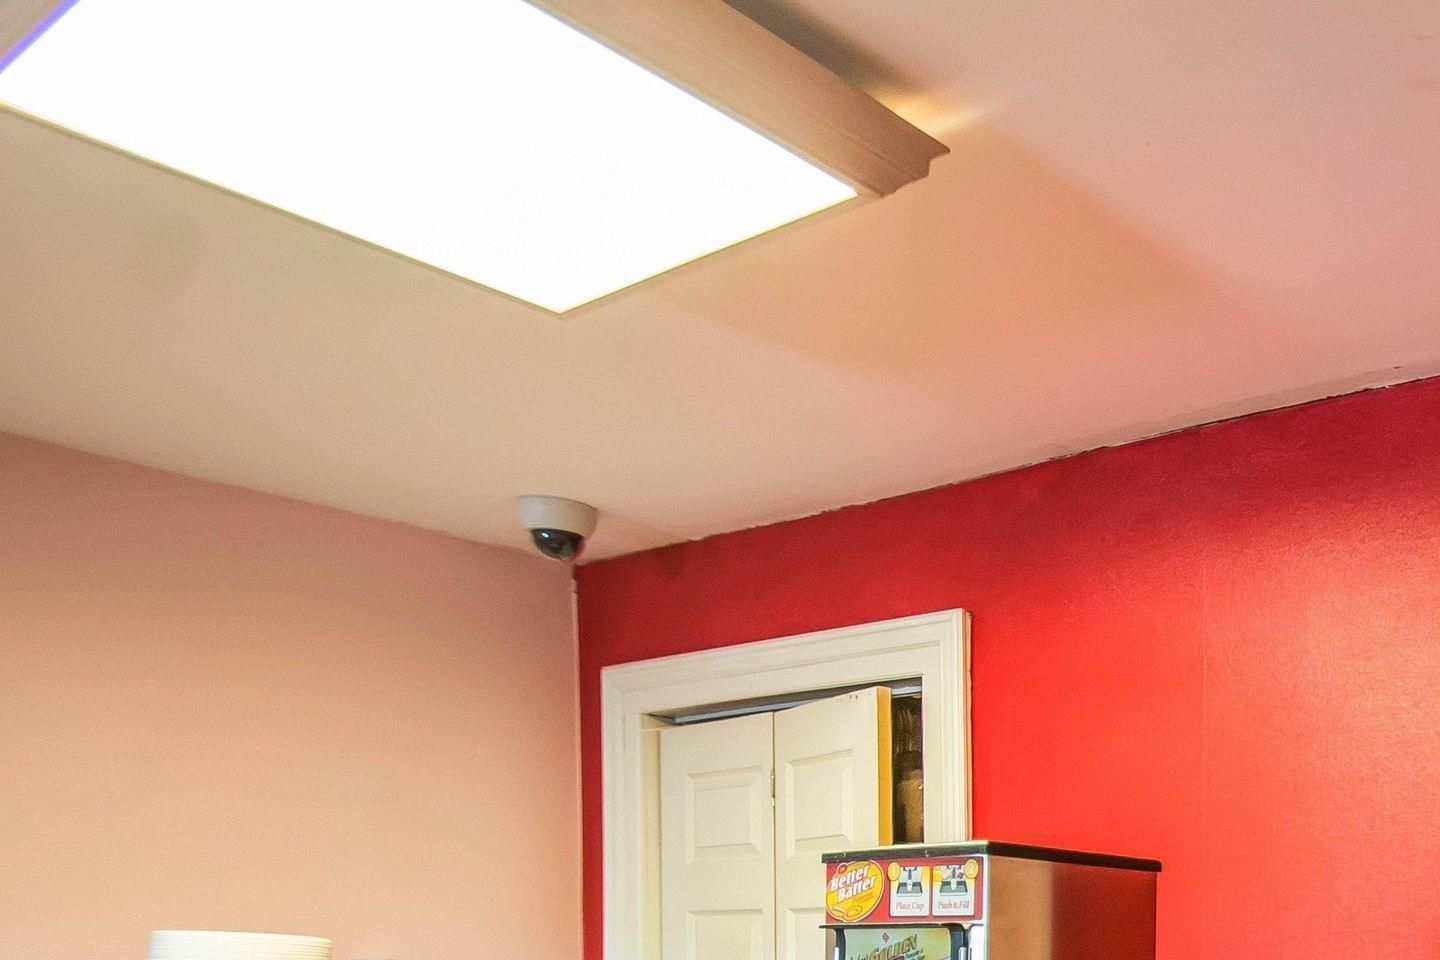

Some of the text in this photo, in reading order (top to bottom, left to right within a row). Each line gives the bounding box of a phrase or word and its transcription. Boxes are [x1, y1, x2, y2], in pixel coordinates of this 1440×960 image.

[830, 865, 869, 892] Better
[837, 875, 876, 903] Batter
[896, 900, 925, 913] Place Cup
